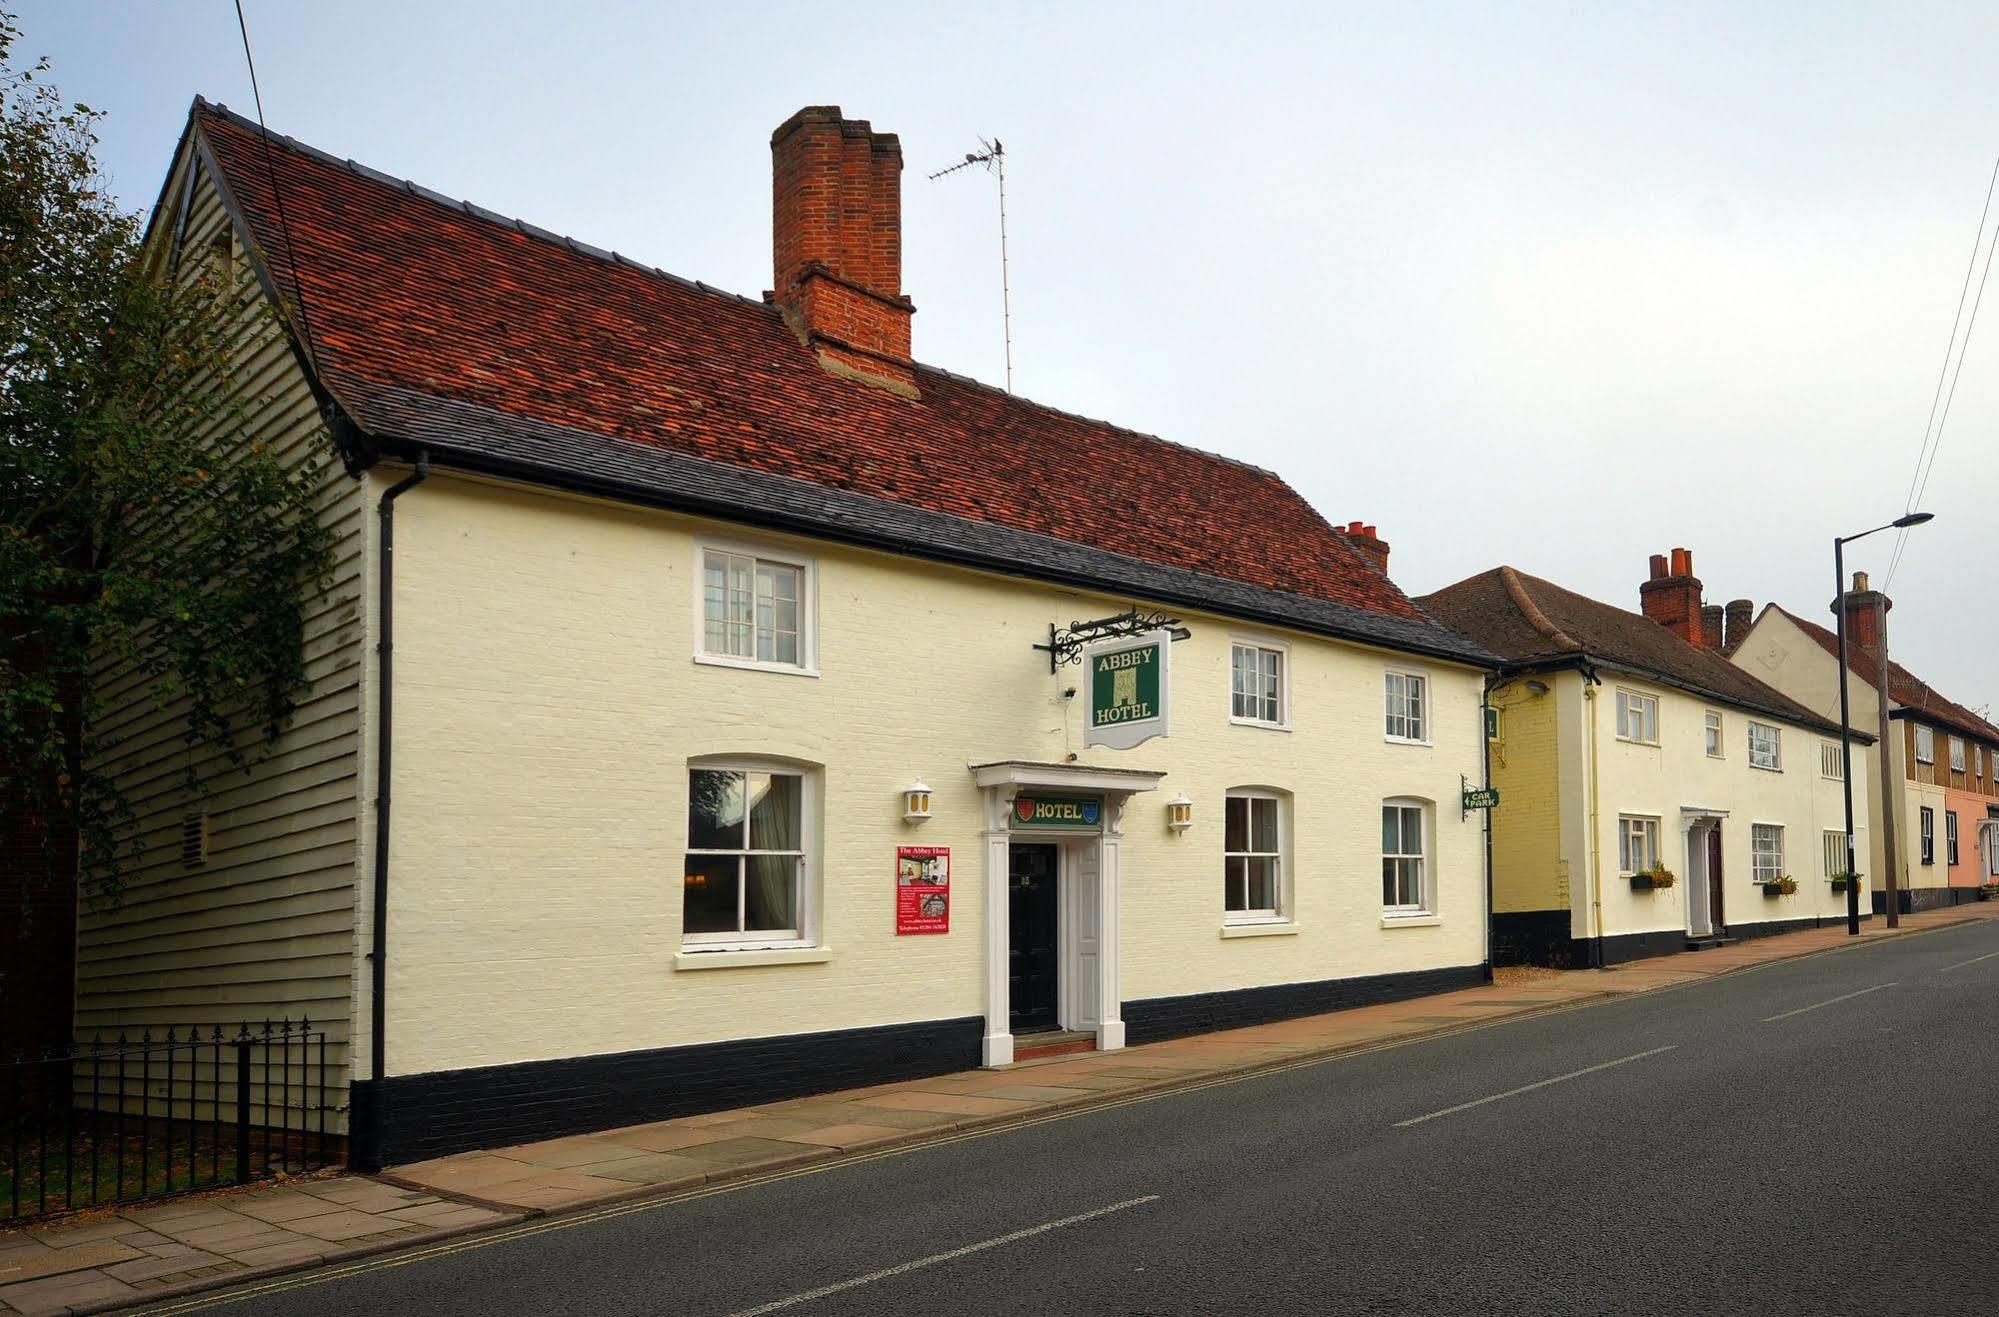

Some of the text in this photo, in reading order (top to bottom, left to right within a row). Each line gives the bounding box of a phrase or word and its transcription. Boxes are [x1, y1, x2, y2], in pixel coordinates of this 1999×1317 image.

[1099, 649, 1153, 671] ABBEY
[1097, 703, 1151, 723] HOTEL
[1470, 799, 1495, 807] PARK
[1472, 793, 1490, 801] CAR
[1036, 803, 1082, 819] HOTEL
